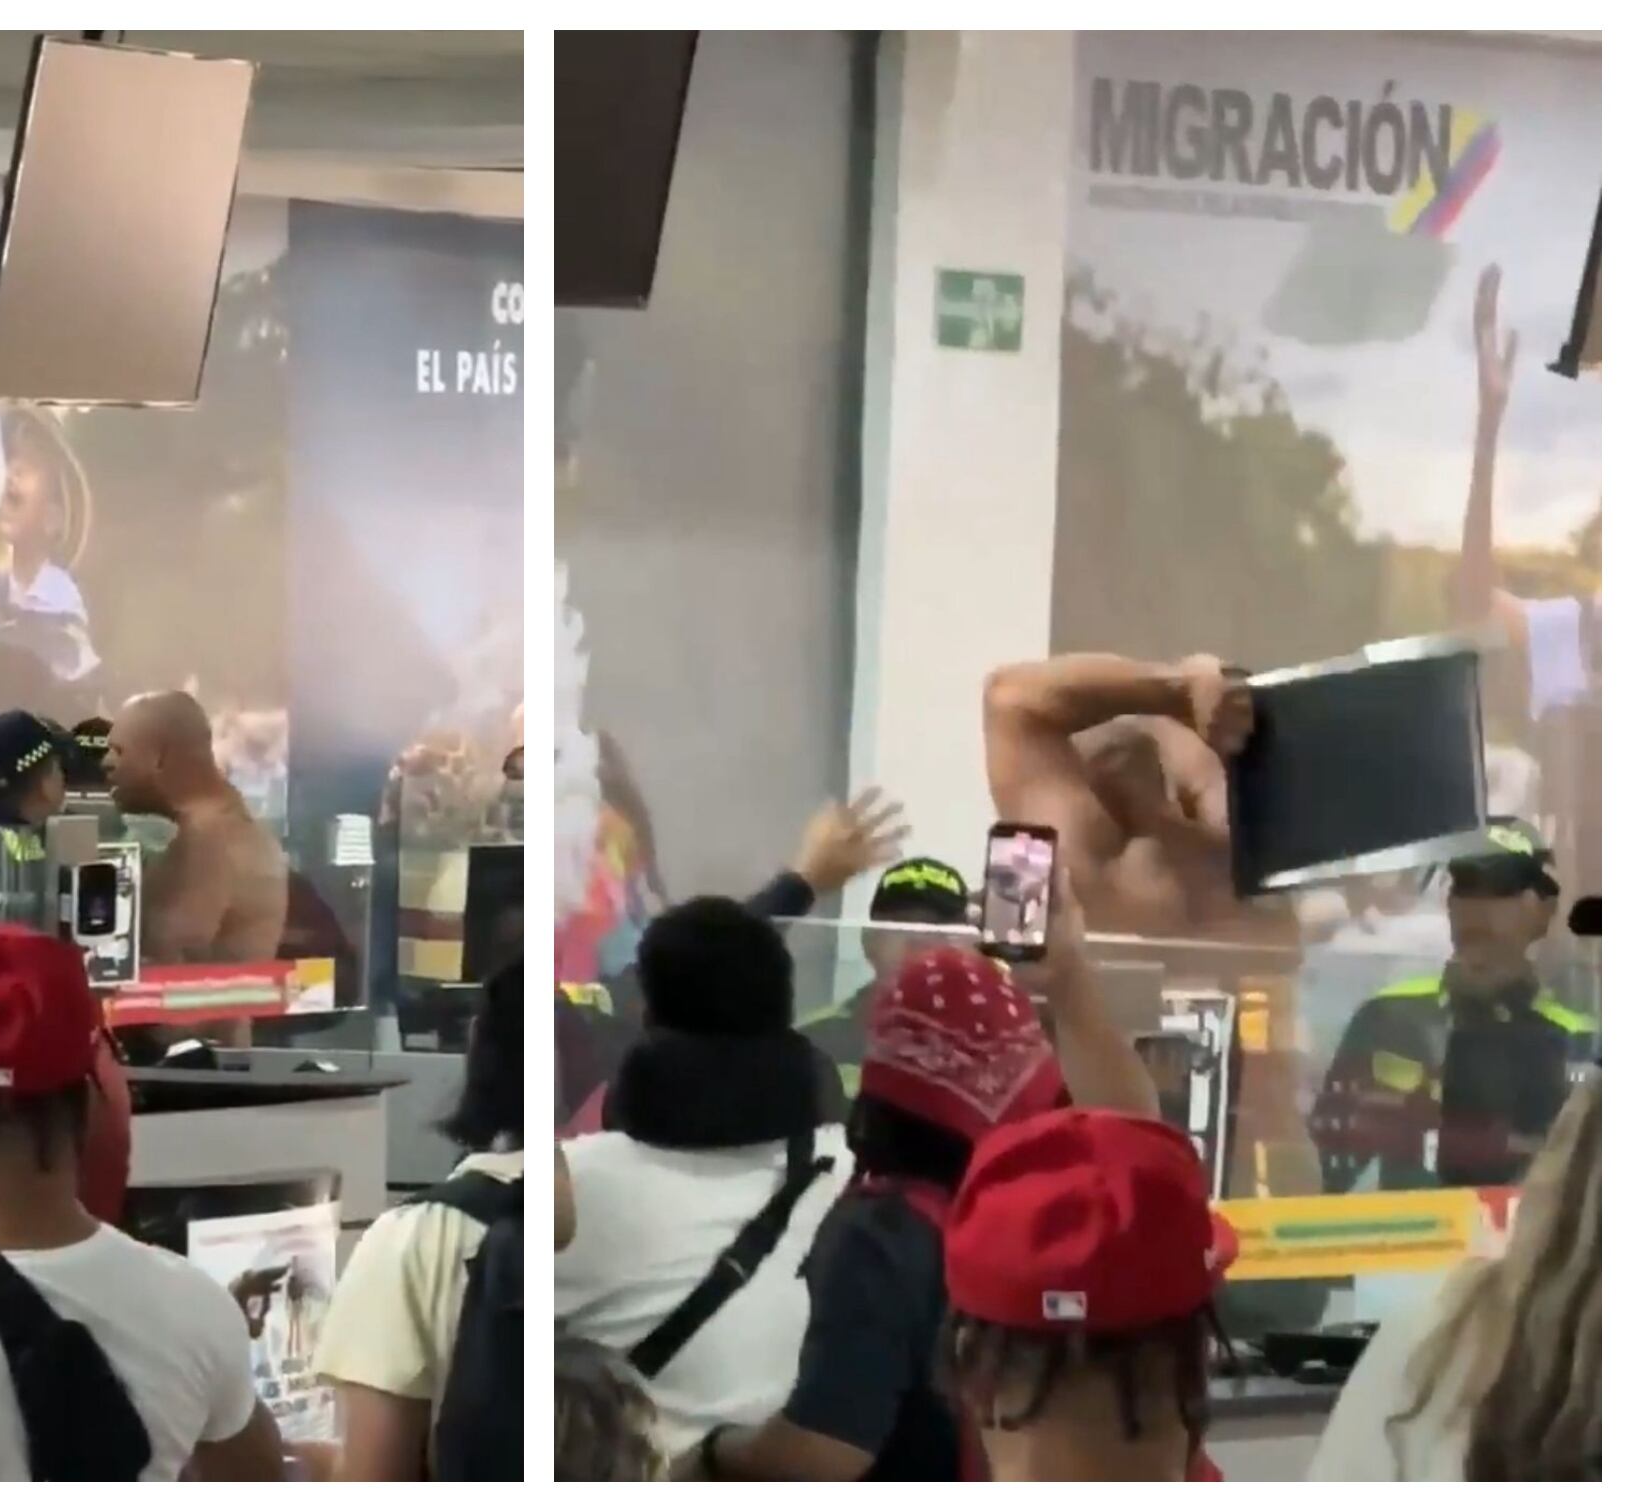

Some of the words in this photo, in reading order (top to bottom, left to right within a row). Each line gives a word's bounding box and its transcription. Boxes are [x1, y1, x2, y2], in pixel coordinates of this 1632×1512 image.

[1090, 77, 1452, 196] MIGRACIÓN
[417, 349, 445, 393] EL
[456, 339, 517, 394] PAÍS
